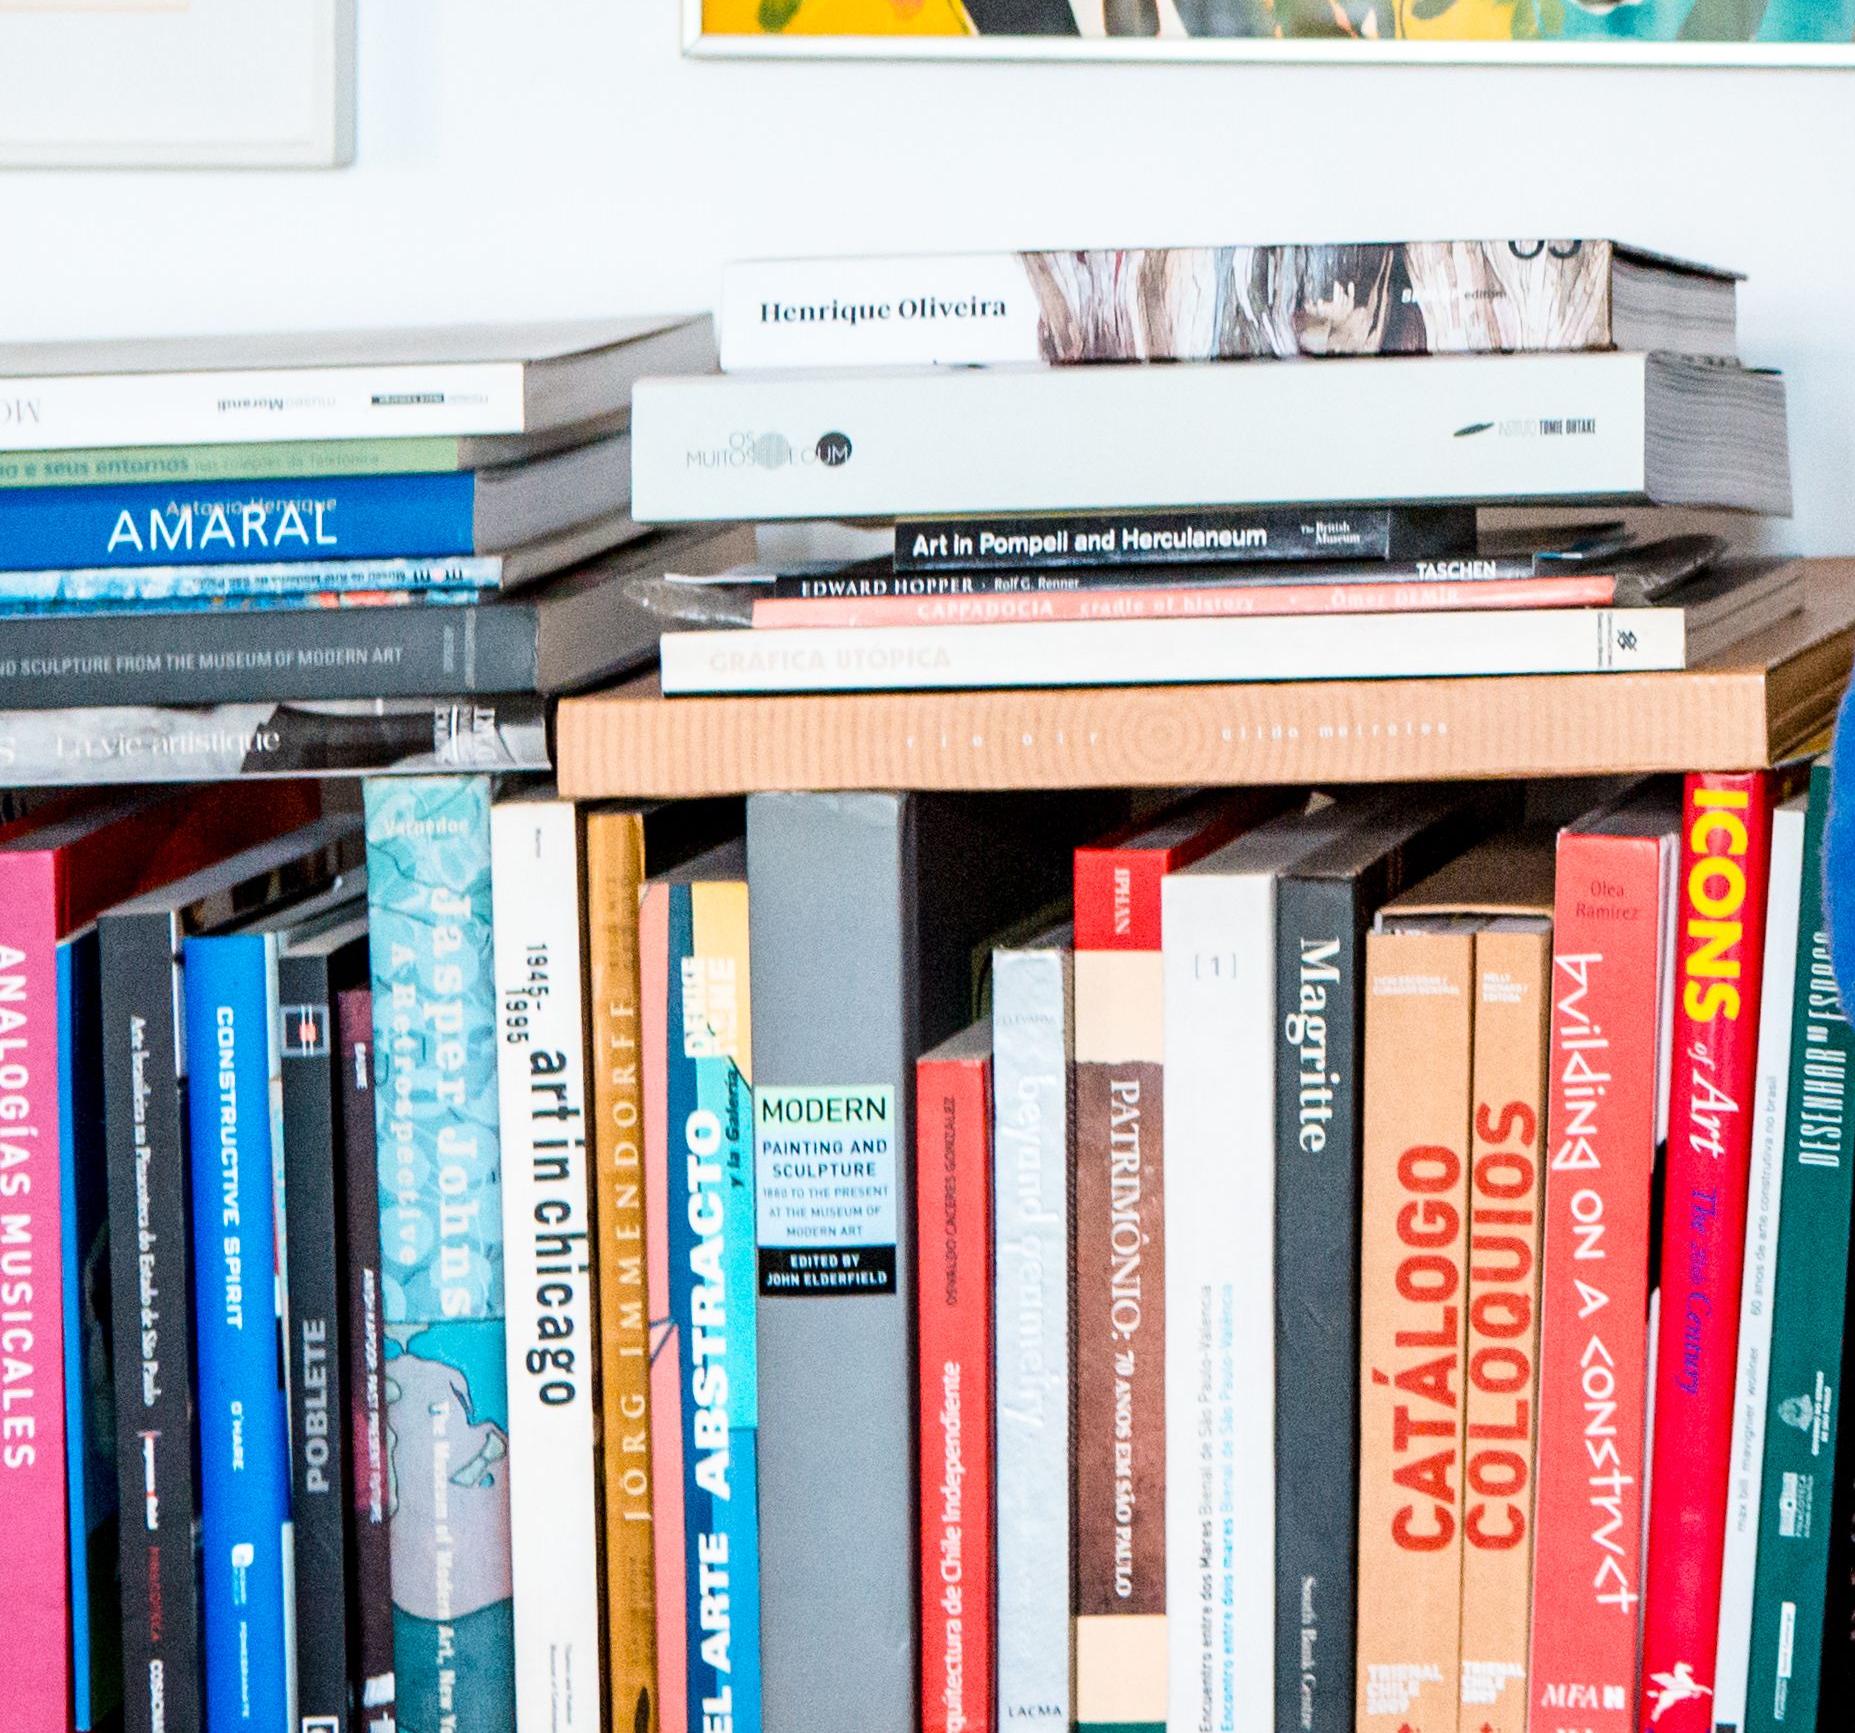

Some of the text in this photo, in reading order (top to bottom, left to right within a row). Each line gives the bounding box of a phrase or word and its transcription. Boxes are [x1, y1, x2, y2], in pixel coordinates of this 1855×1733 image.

[759, 295, 1008, 326] Henrique Oliveira
[1538, 419, 1597, 436] TOMIE OHTAKE
[816, 443, 850, 464] UM
[107, 503, 338, 553] AMARAL
[166, 496, 338, 518] Antonio Henrique
[1315, 520, 1350, 536] British
[911, 525, 1268, 559] Art in Pompeii and Herculaneum
[1315, 532, 1361, 546] Museum
[801, 573, 1080, 597] EDWARD HOPPER Rolf Renner
[1416, 561, 1497, 581] TASCHEN
[916, 599, 1054, 620] CAPPADOCIA
[1080, 598, 1144, 617] cradle
[1153, 596, 1174, 614] of
[1183, 594, 1256, 617] history
[20, 646, 403, 677] SCULPTURE FROM THE MUSEUM OF MODERN ART
[709, 639, 952, 676] GRÁFICA UTÓPICA
[100, 727, 281, 760] vie artistique
[1113, 867, 1131, 936] IPHAN
[1590, 880, 1624, 898] Olea
[1683, 787, 1749, 1023] ICONS
[523, 941, 548, 1012] 1945-
[130, 1015, 148, 1050] Arte
[505, 986, 529, 1045] 1995
[1285, 936, 1341, 1153] Magritte
[1688, 1040, 1715, 1069] of
[132, 1051, 154, 1123] brasileira
[391, 941, 421, 1266] A Retrospective
[423, 886, 480, 1319] Jasper Johns
[762, 1096, 887, 1123] MODERN
[1798, 1047, 1847, 1168] DESENHAR
[1687, 1067, 1742, 1159] Art
[216, 1005, 243, 1330] CONSTRUCTIVE SPIRIT
[762, 1138, 888, 1157] PAINTING AND
[772, 1162, 877, 1178] SCULPTURE
[0, 945, 38, 1470] ANALOGÍAS MUSICALES
[135, 1147, 154, 1229] Pinacoteca
[791, 1186, 805, 1198] TO
[809, 1186, 830, 1198] THE
[834, 1185, 889, 1199] PRESENT
[1754, 1075, 1778, 1296] anos arte construtiva brasil
[526, 1048, 588, 1408] art in chicago
[769, 1205, 881, 1218] AT THE MUSEUM OF
[786, 1225, 863, 1238] MODERN ART
[1688, 1187, 1719, 1234] The
[138, 1229, 157, 1252] do
[607, 998, 652, 1520] JÖRG IMMENDORFF
[789, 1254, 861, 1269] EDITED BY
[1001, 1074, 1062, 1430] beyond geometry
[139, 1253, 160, 1306] Estado
[766, 1271, 888, 1287] JOHN ELDERFIELD
[141, 1307, 160, 1329] de
[1109, 1080, 1150, 1599] PATRIMÔNIO: 70 ANOS EM SÃO PAULO
[1463, 1100, 1537, 1552] COLOQUIOS
[141, 1329, 160, 1360] São
[1370, 1144, 1461, 1553] CATÁLOGO
[1676, 1290, 1716, 1395] Century
[142, 1360, 162, 1407] Paulo
[302, 1318, 331, 1494] POBLETE
[684, 1109, 733, 1733] EL ARTE ABSTRACTO
[1737, 1501, 1748, 1533] max
[1746, 1346, 1760, 1397] wollner
[937, 1361, 966, 1616] de Chile Independiente
[431, 1401, 456, 1710] The Museum Modern Art, New
[1199, 1520, 1213, 1569] Mares
[1221, 1518, 1234, 1569] mares
[1199, 1573, 1213, 1601] dos
[1200, 1606, 1213, 1648] entre
[1220, 1611, 1234, 1655] entre
[1300, 1574, 1318, 1671] South Bank
[1008, 1704, 1062, 1718] LACMA
